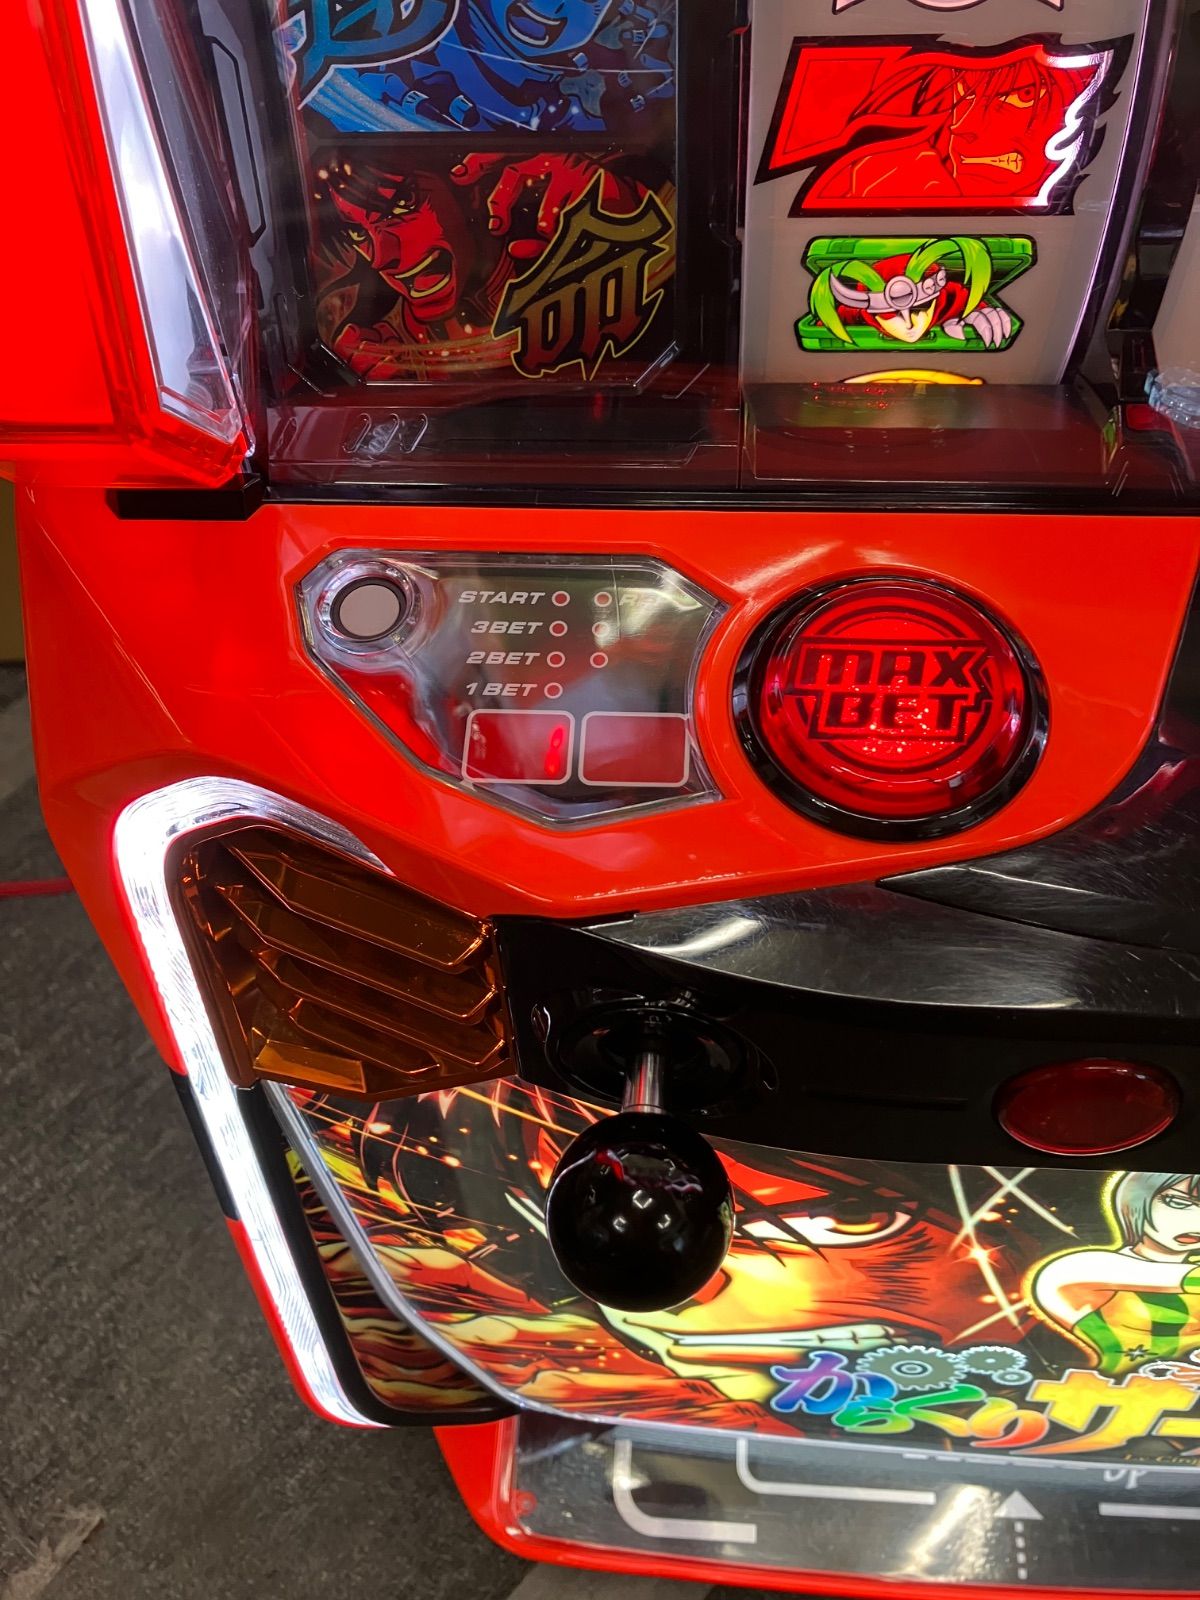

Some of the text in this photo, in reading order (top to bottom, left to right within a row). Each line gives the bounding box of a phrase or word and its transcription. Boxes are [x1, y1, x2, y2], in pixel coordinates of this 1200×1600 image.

[458, 590, 546, 605] START
[470, 620, 543, 635] 3BET
[465, 651, 541, 665] 2BET
[801, 649, 973, 688] MAX
[824, 693, 970, 730] BET
